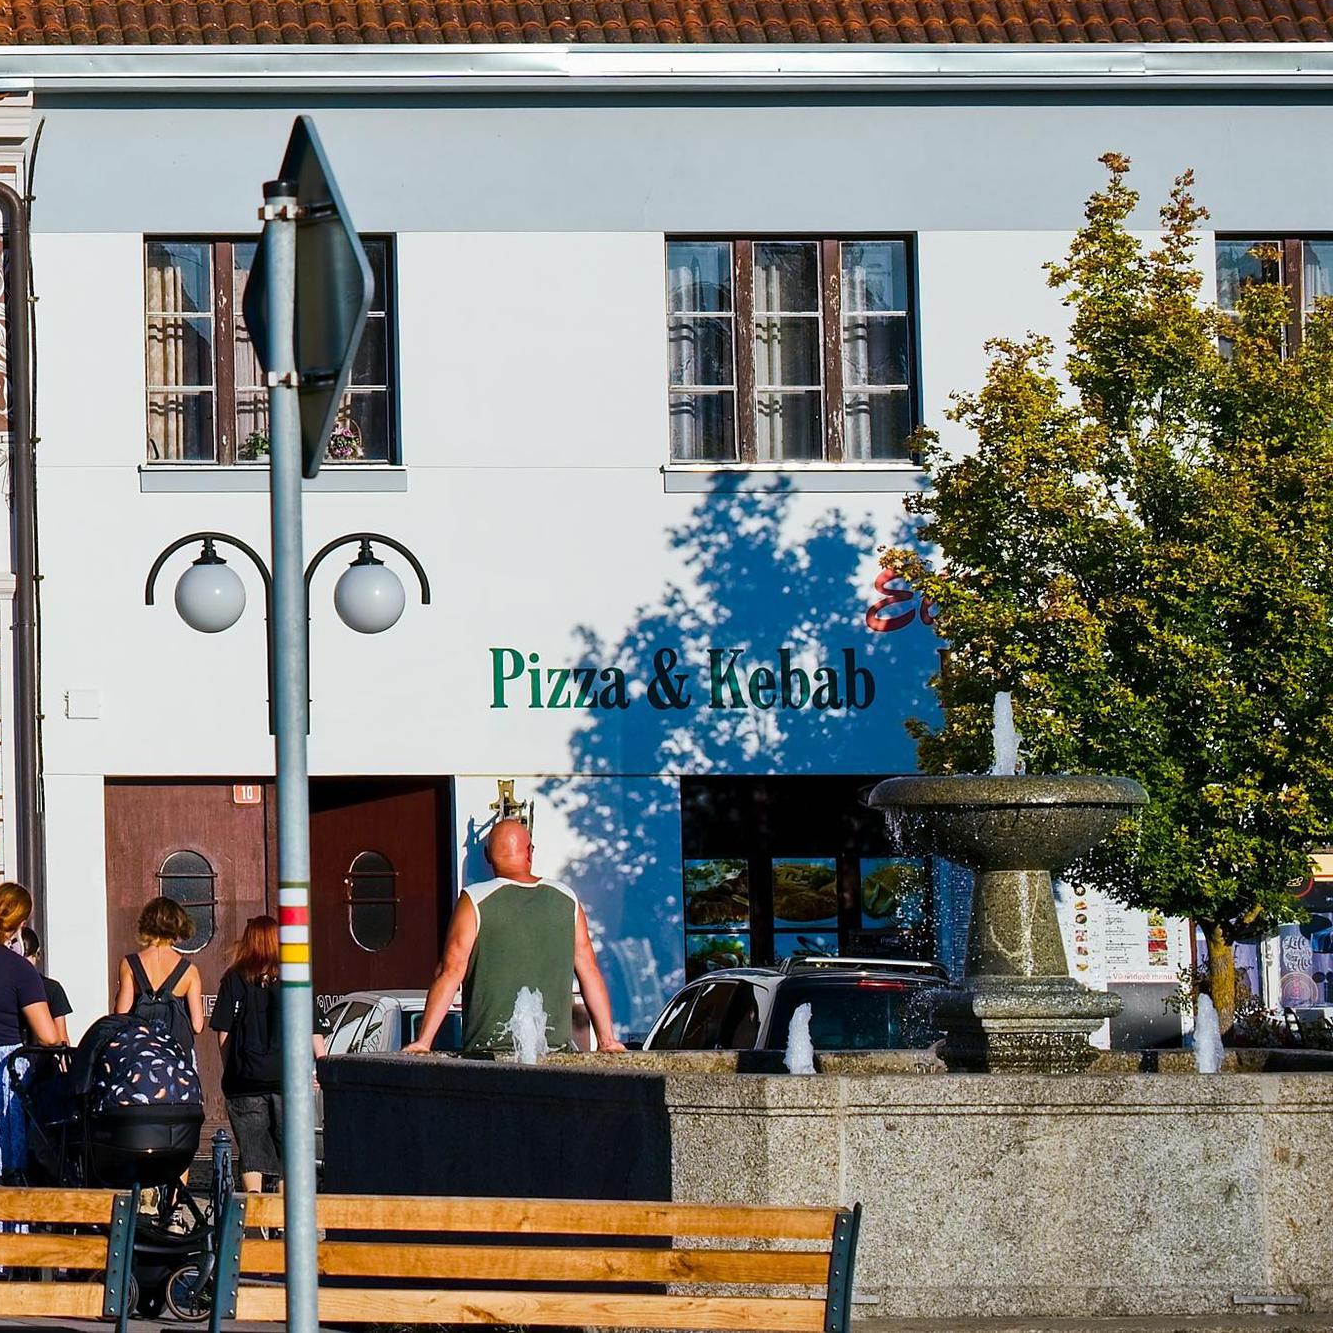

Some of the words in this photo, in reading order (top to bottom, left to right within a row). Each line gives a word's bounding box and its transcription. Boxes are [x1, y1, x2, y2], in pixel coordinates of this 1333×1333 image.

[489, 647, 630, 709] Pizza
[646, 647, 692, 710] &
[707, 647, 876, 710] Kebab
[241, 785, 254, 801] 10
